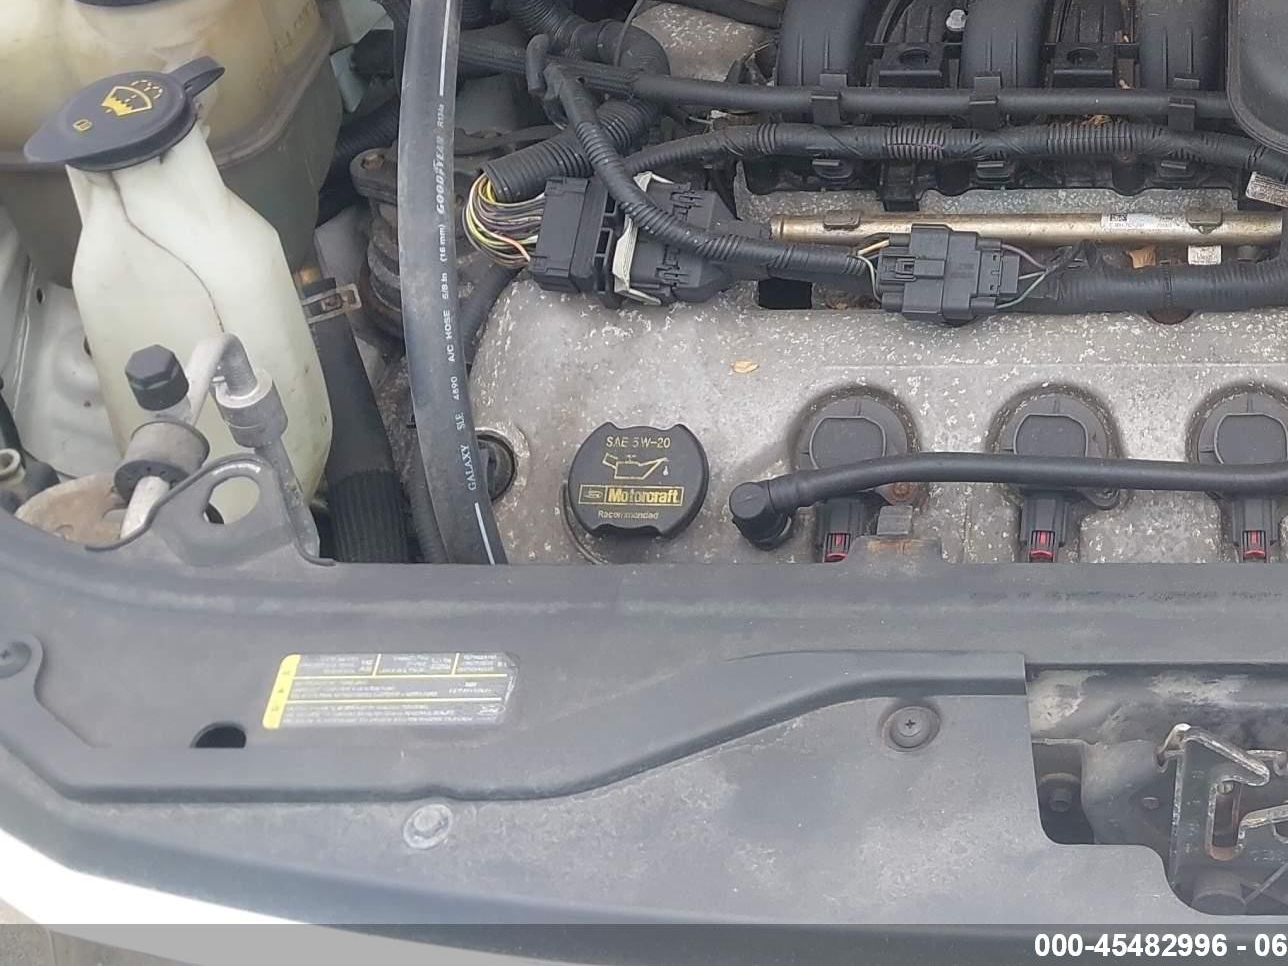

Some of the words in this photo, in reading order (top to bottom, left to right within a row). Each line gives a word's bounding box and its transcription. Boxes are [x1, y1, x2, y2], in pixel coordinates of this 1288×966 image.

[433, 136, 446, 214] GOODYEAR
[438, 224, 446, 245] mm)
[440, 246, 448, 262] (16
[443, 309, 453, 340] HOSE
[446, 344, 455, 362] A/C
[455, 412, 465, 431] SLE
[606, 436, 629, 448] SAE
[632, 437, 671, 448] 5W-20
[460, 444, 477, 491] GALAXY
[608, 488, 680, 503] Motorcraft
